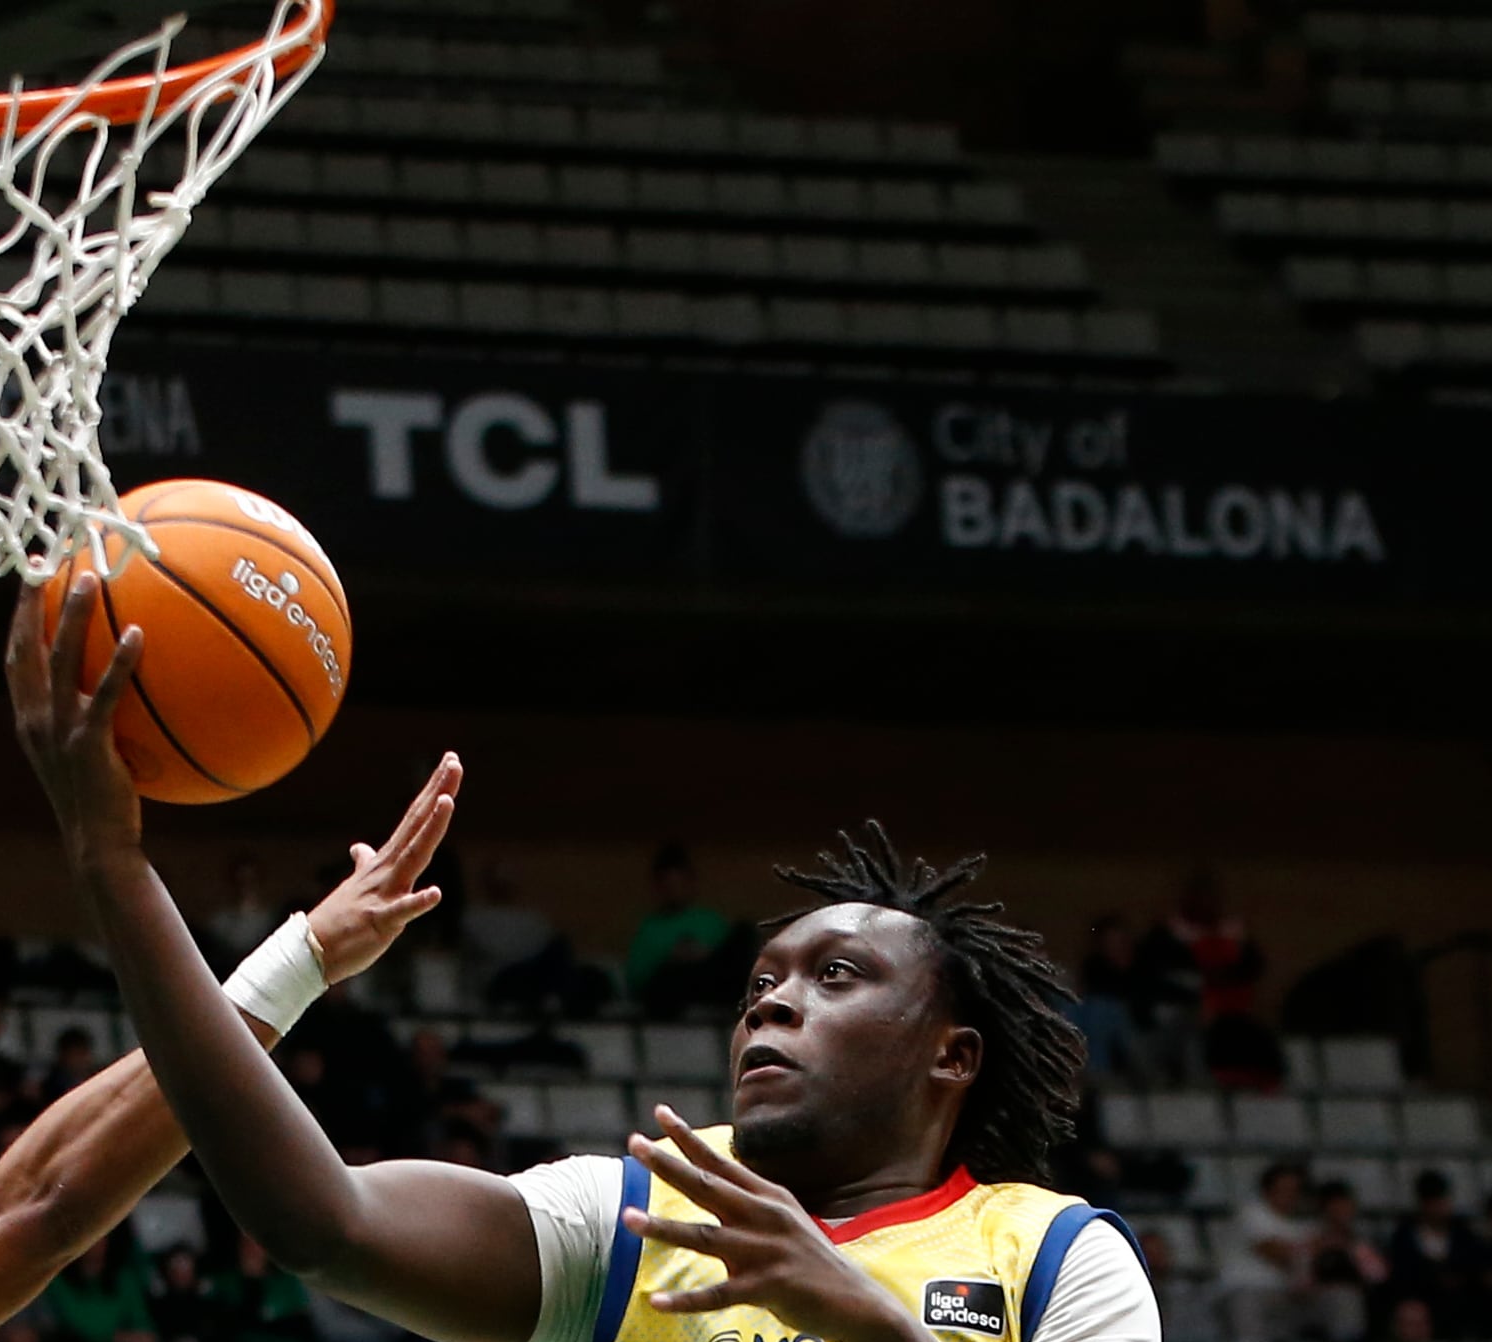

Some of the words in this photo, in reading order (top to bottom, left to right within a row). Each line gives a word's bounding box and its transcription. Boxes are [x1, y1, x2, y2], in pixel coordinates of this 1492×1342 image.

[331, 388, 661, 512] TCL
[929, 402, 1053, 474] City
[1065, 408, 1132, 468] of
[938, 472, 1387, 562] BADALONA
[232, 557, 287, 610] liga
[286, 602, 344, 699] ende
[930, 1307, 1001, 1330] endesa
[931, 1291, 965, 1309] liga
